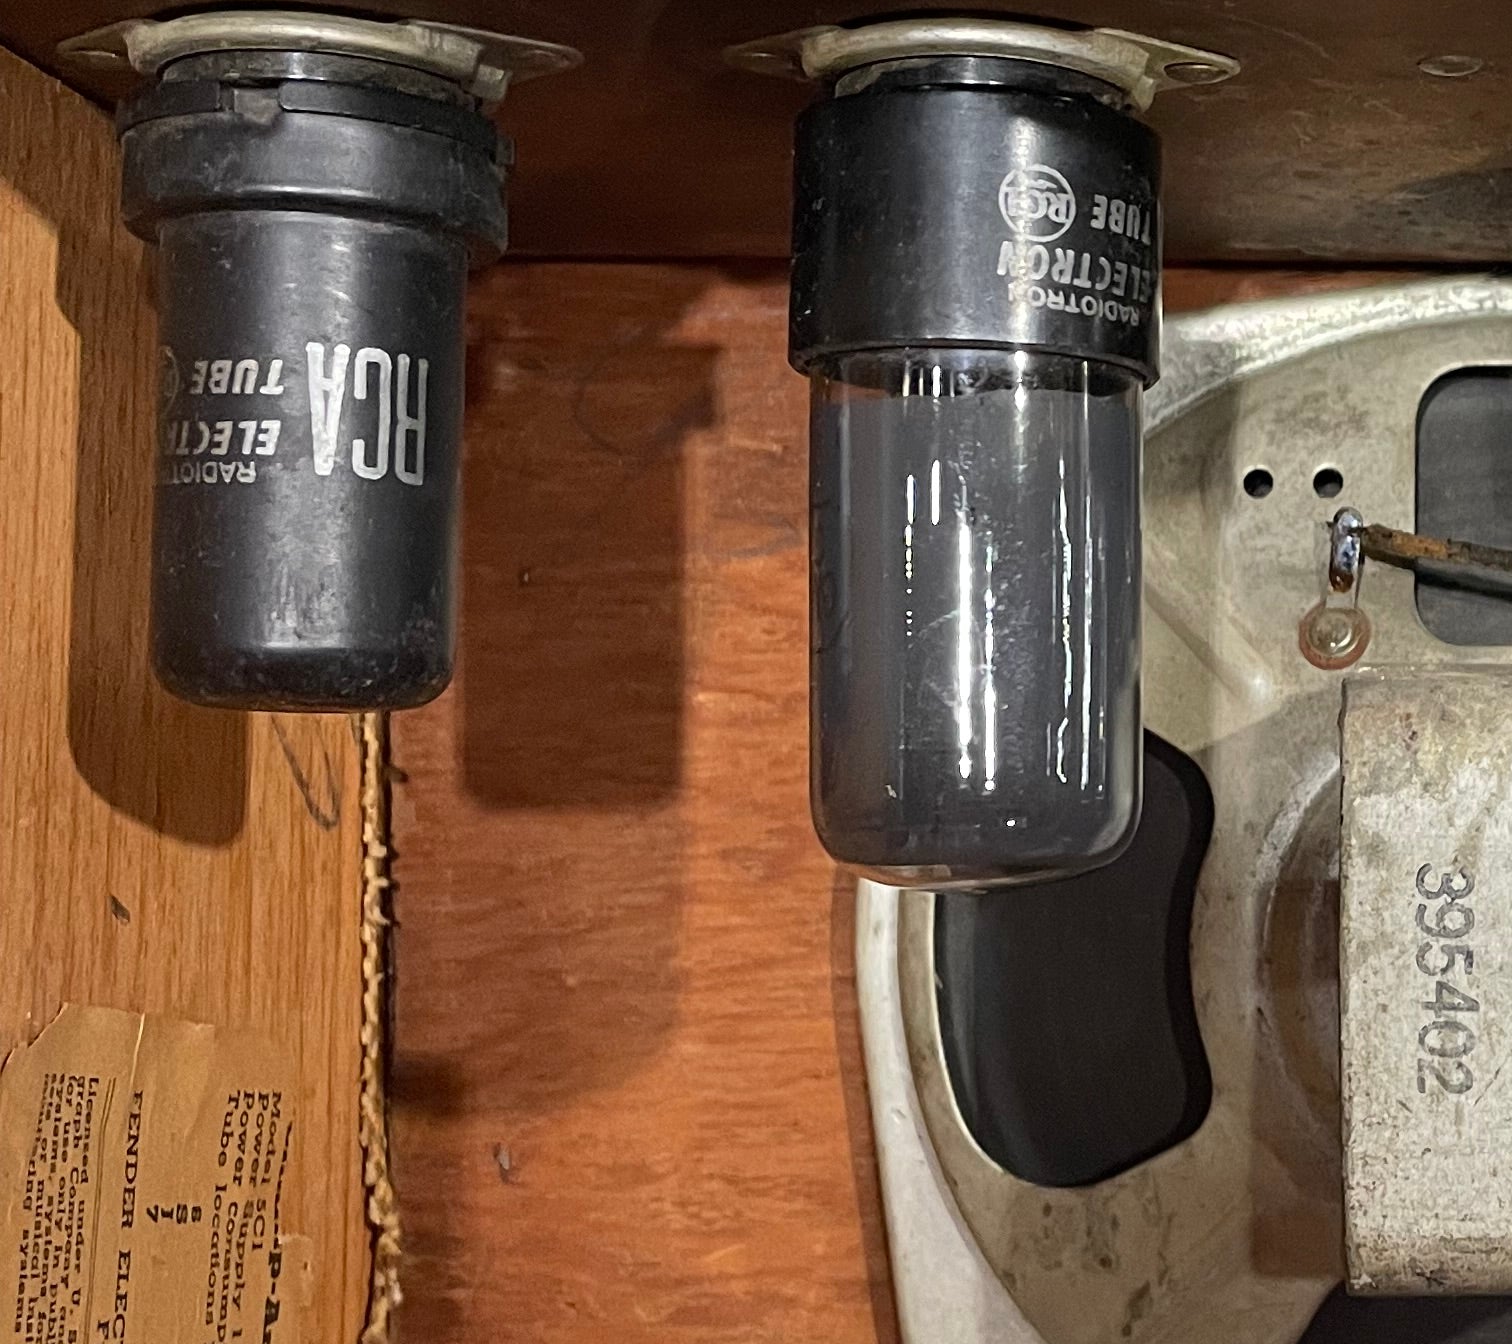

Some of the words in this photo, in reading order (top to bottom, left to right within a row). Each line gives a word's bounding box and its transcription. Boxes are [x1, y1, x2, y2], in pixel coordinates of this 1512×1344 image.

[1090, 193, 1151, 246] TUBE
[190, 358, 284, 396] TUBE
[305, 341, 429, 486] RCA
[1415, 862, 1481, 1094] 395402
[61, 1120, 71, 1163] use
[73, 1076, 85, 1149] graph
[80, 1078, 99, 1184] Licensed
[121, 1090, 143, 1229] FENDER
[218, 1090, 241, 1167] Tube
[233, 1090, 255, 1187] Power
[249, 1091, 269, 1188] Power
[260, 1090, 282, 1185] Model
[30, 1179, 45, 1279] musical
[54, 1176, 66, 1232] only
[60, 1167, 79, 1289] Company
[74, 1200, 85, 1274] under
[252, 1198, 266, 1251] 5C1
[52, 1245, 63, 1269] in
[205, 1184, 227, 1326] locations
[232, 1200, 254, 1311] Supply
